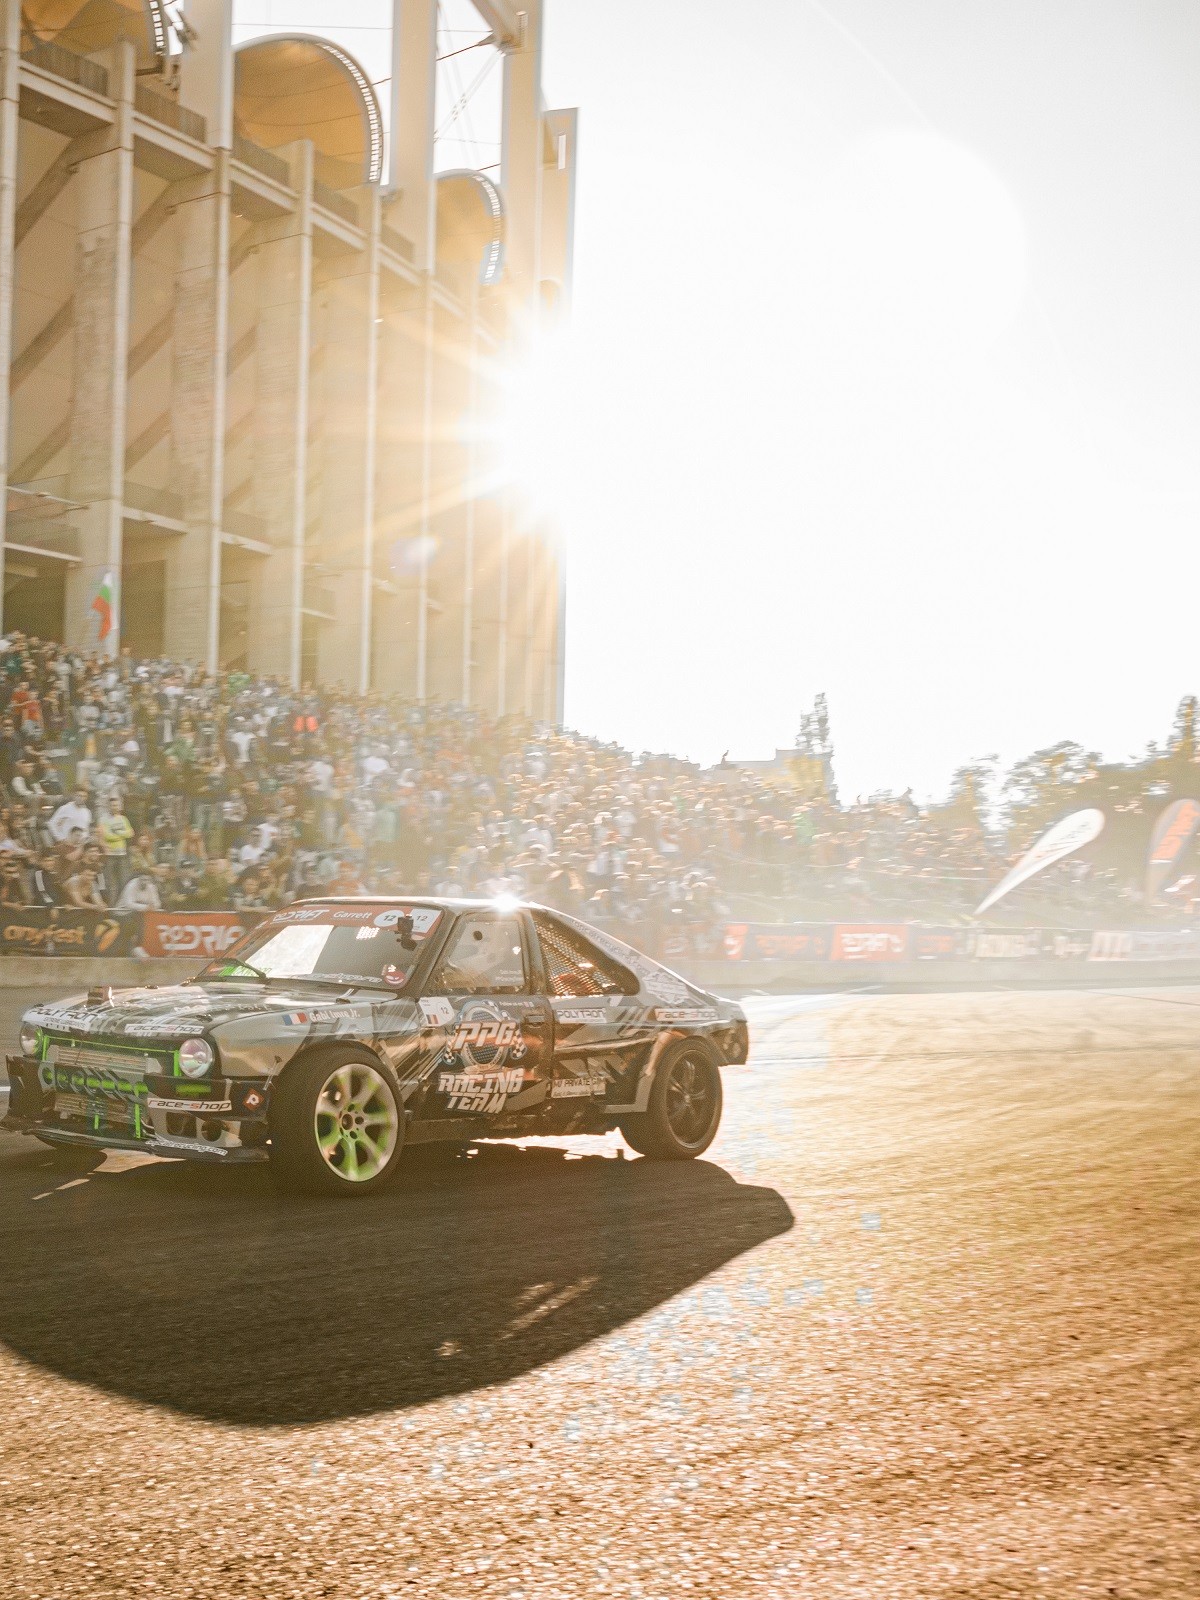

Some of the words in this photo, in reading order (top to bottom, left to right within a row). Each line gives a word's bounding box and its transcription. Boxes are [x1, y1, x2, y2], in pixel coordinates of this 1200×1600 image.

[333, 911, 372, 919] Garrett
[3, 923, 88, 945] anyfest
[658, 1010, 717, 1019] race-shop
[127, 1025, 203, 1033] race-shop
[452, 1021, 516, 1050] PPG
[438, 1068, 524, 1093] RACING
[149, 1100, 231, 1111] race-shop
[447, 1092, 507, 1114] TEAM
